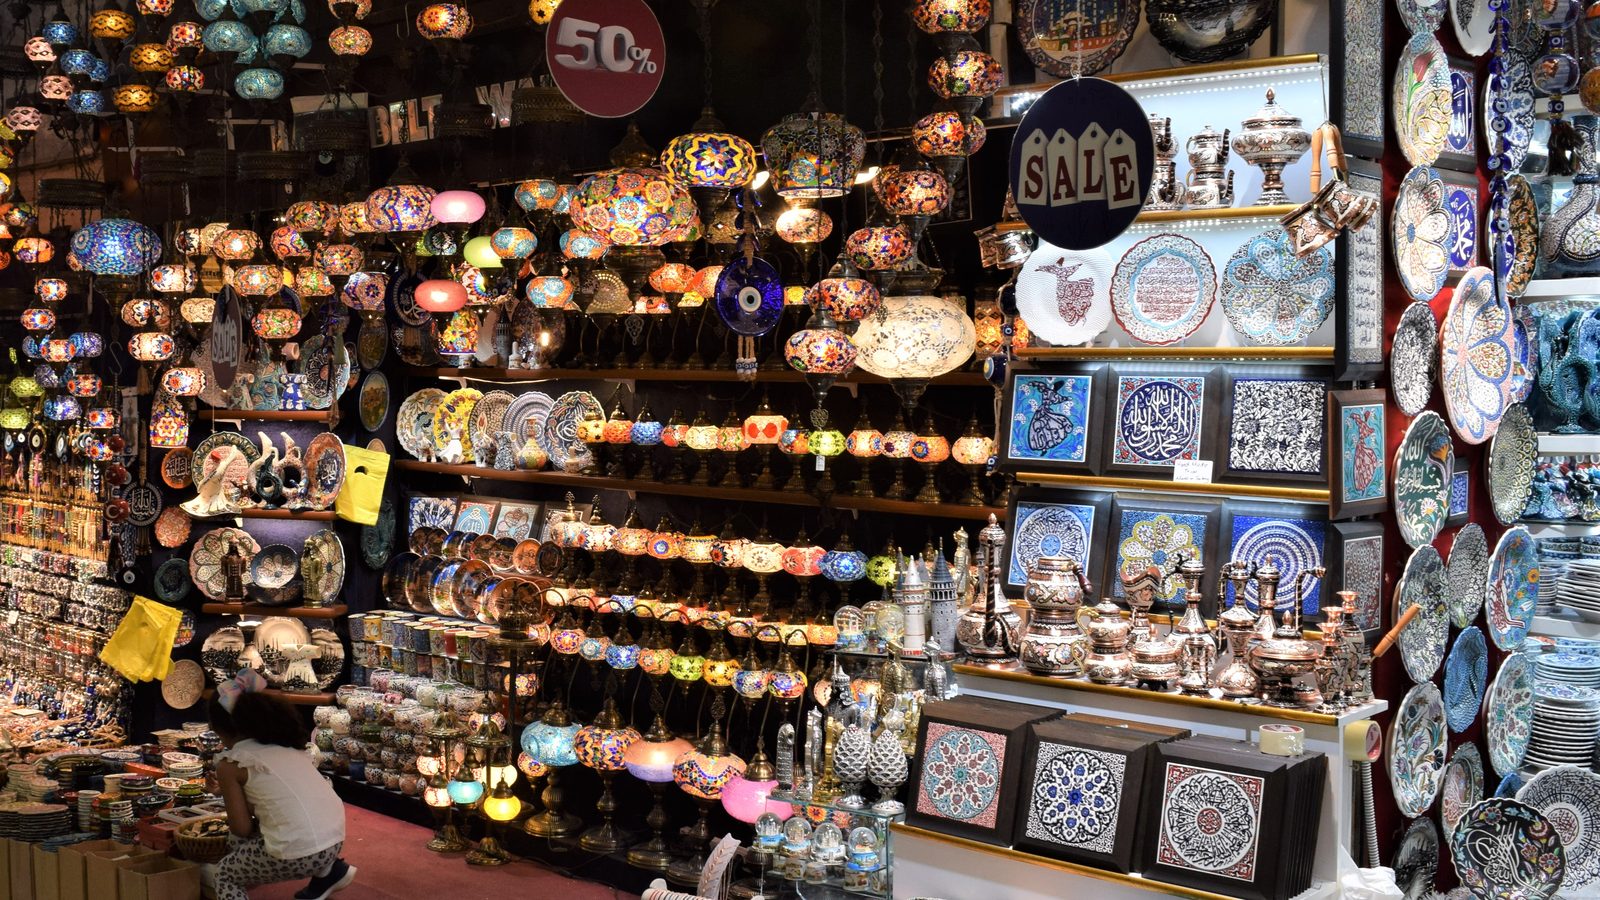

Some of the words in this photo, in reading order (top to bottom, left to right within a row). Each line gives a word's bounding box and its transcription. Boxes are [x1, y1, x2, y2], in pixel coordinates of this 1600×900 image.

[554, 17, 657, 74] 50%
[1024, 149, 1135, 203] SALE
[213, 331, 236, 363] SALE
